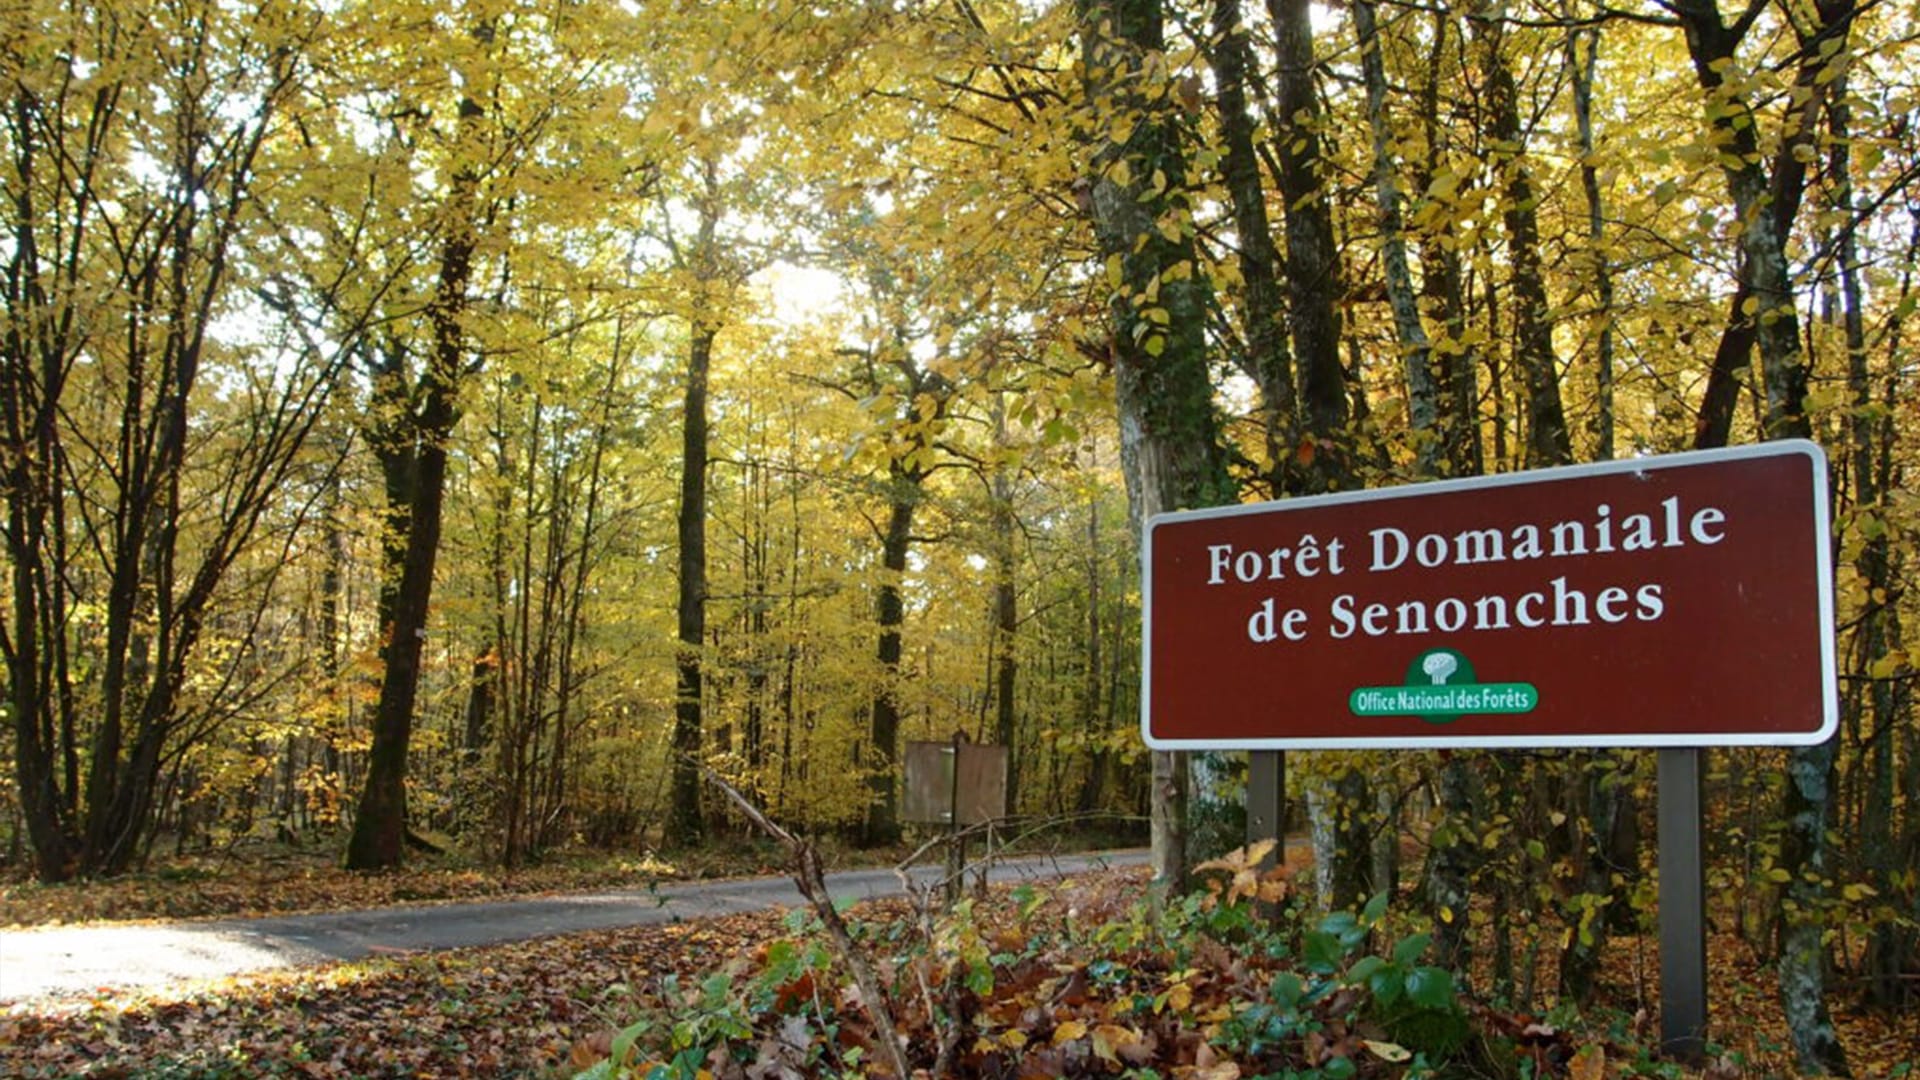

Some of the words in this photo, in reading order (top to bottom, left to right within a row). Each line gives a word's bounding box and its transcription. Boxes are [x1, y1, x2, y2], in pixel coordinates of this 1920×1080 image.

[1207, 534, 1345, 586] Forêt
[1369, 495, 1726, 573] Domaniale
[1247, 597, 1308, 644] de
[1330, 575, 1665, 640] Senonches
[1357, 691, 1395, 710] Office
[1398, 690, 1455, 710] National
[1457, 690, 1480, 709] des
[1482, 688, 1529, 708] Forêts
